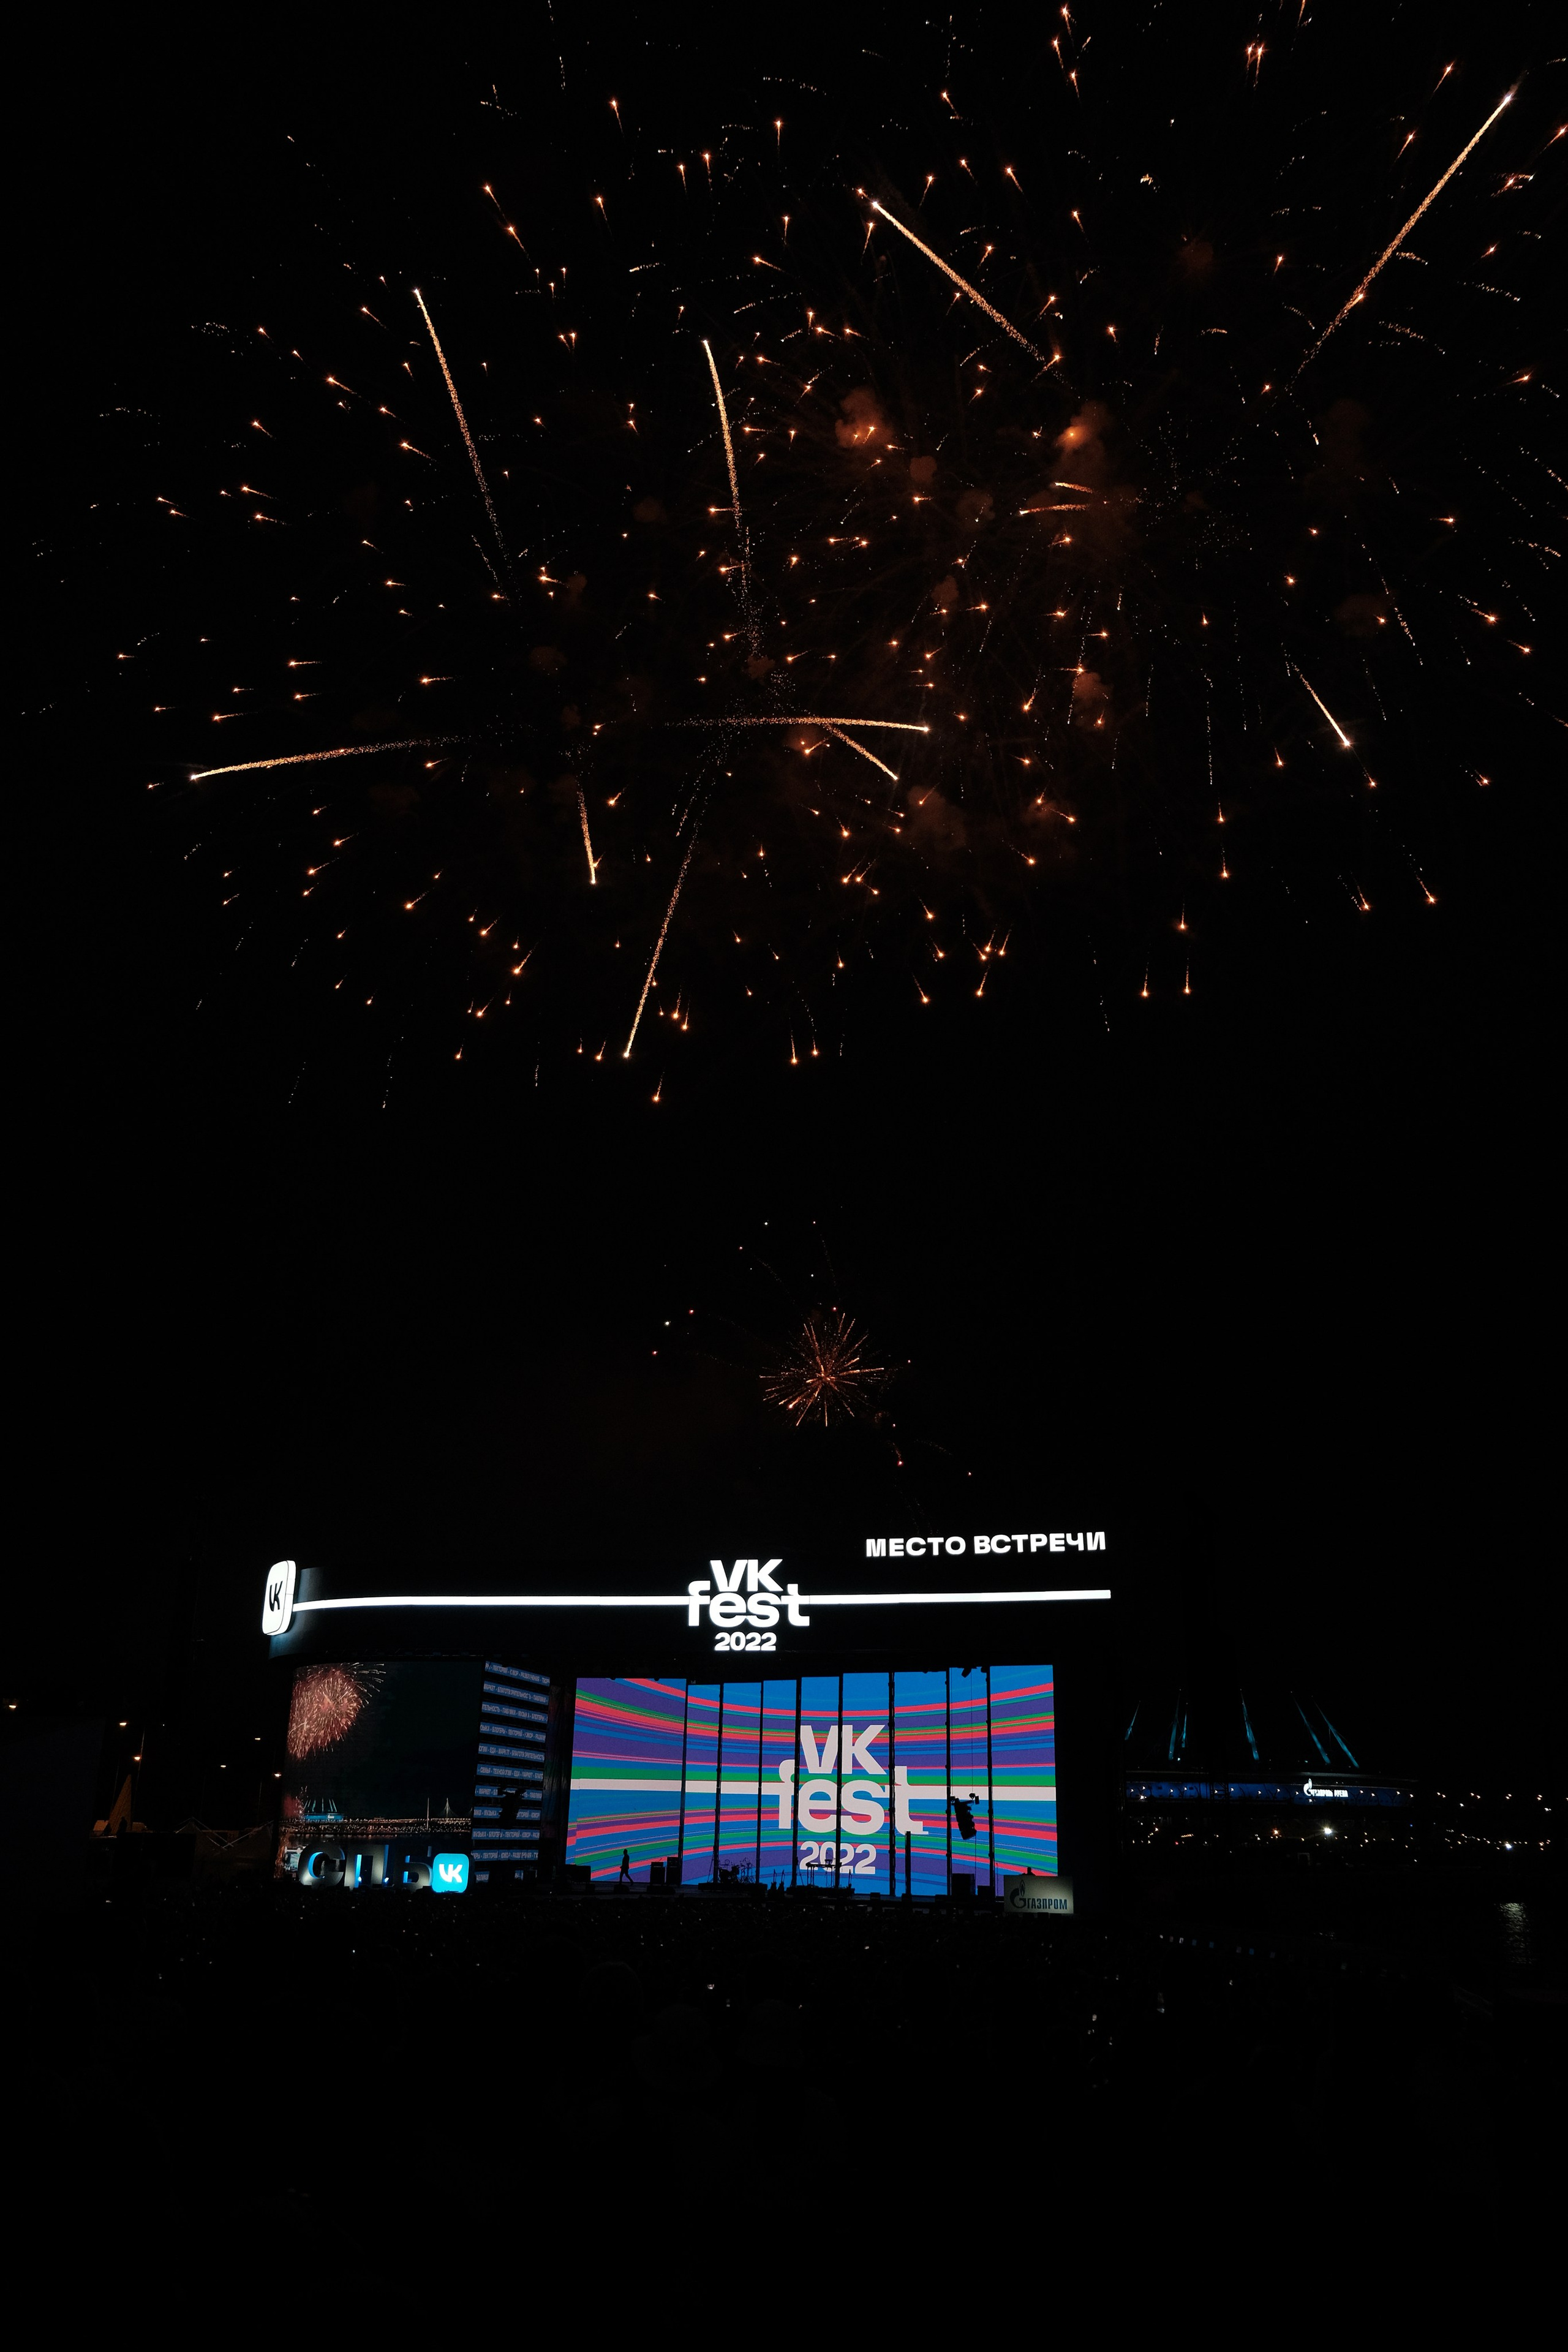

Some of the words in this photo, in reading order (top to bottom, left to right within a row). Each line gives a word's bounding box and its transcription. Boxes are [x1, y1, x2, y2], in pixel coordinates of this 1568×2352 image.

[866, 1536, 966, 1557] МЕСТО
[974, 1531, 1106, 1554] ВСТРЕЧИ
[710, 1559, 784, 1591] VK
[688, 1580, 810, 1627] fest
[714, 1632, 777, 1651] 2022
[800, 1724, 888, 1774] VK
[778, 1759, 929, 1835] fest
[439, 1863, 464, 1883] VK
[799, 1841, 877, 1875] 2022
[1027, 1898, 1068, 1910] ГАЗПРОМ
